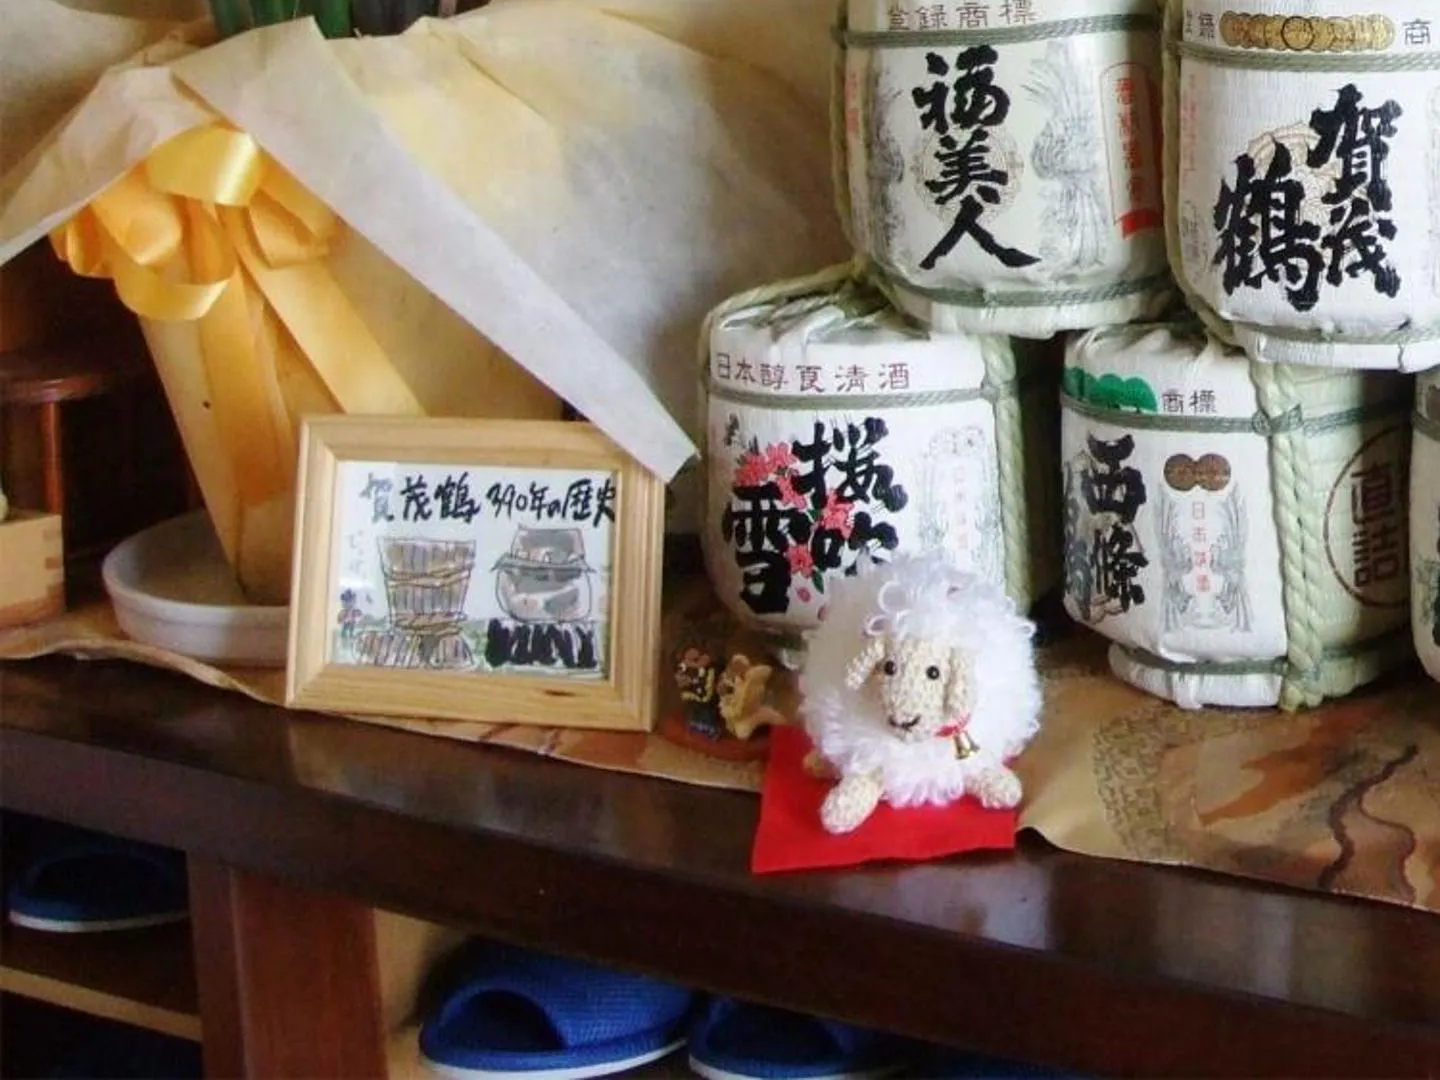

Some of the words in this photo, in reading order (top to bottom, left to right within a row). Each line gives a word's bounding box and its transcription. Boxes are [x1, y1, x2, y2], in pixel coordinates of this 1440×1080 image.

[912, 44, 1042, 270] 福美人
[1162, 388, 1218, 414] 商標
[360, 471, 482, 524] 賀茂鶴
